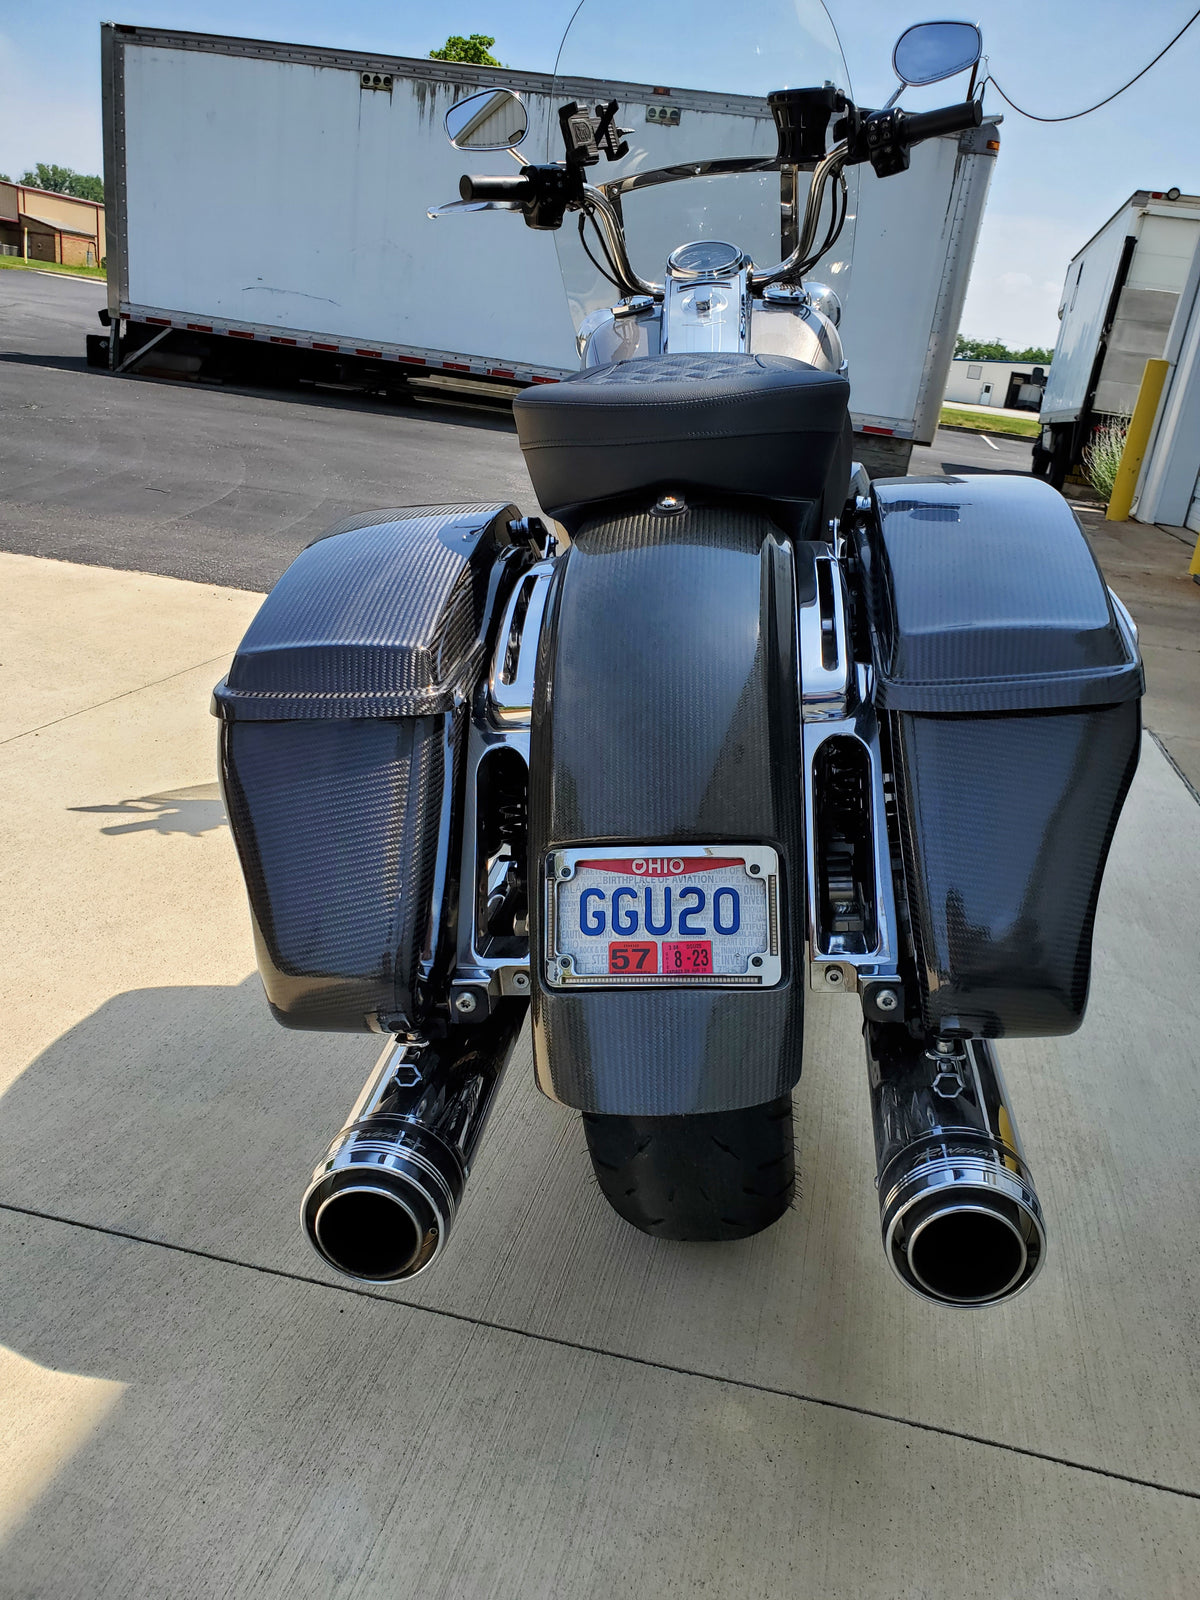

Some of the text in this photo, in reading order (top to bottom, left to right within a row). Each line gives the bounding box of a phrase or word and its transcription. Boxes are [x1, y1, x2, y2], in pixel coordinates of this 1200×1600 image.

[632, 858, 685, 874] OHIO
[602, 875, 714, 885] BIRTHPLACE OF AVIATION
[580, 886, 740, 937] GGU20
[611, 948, 651, 970] 57
